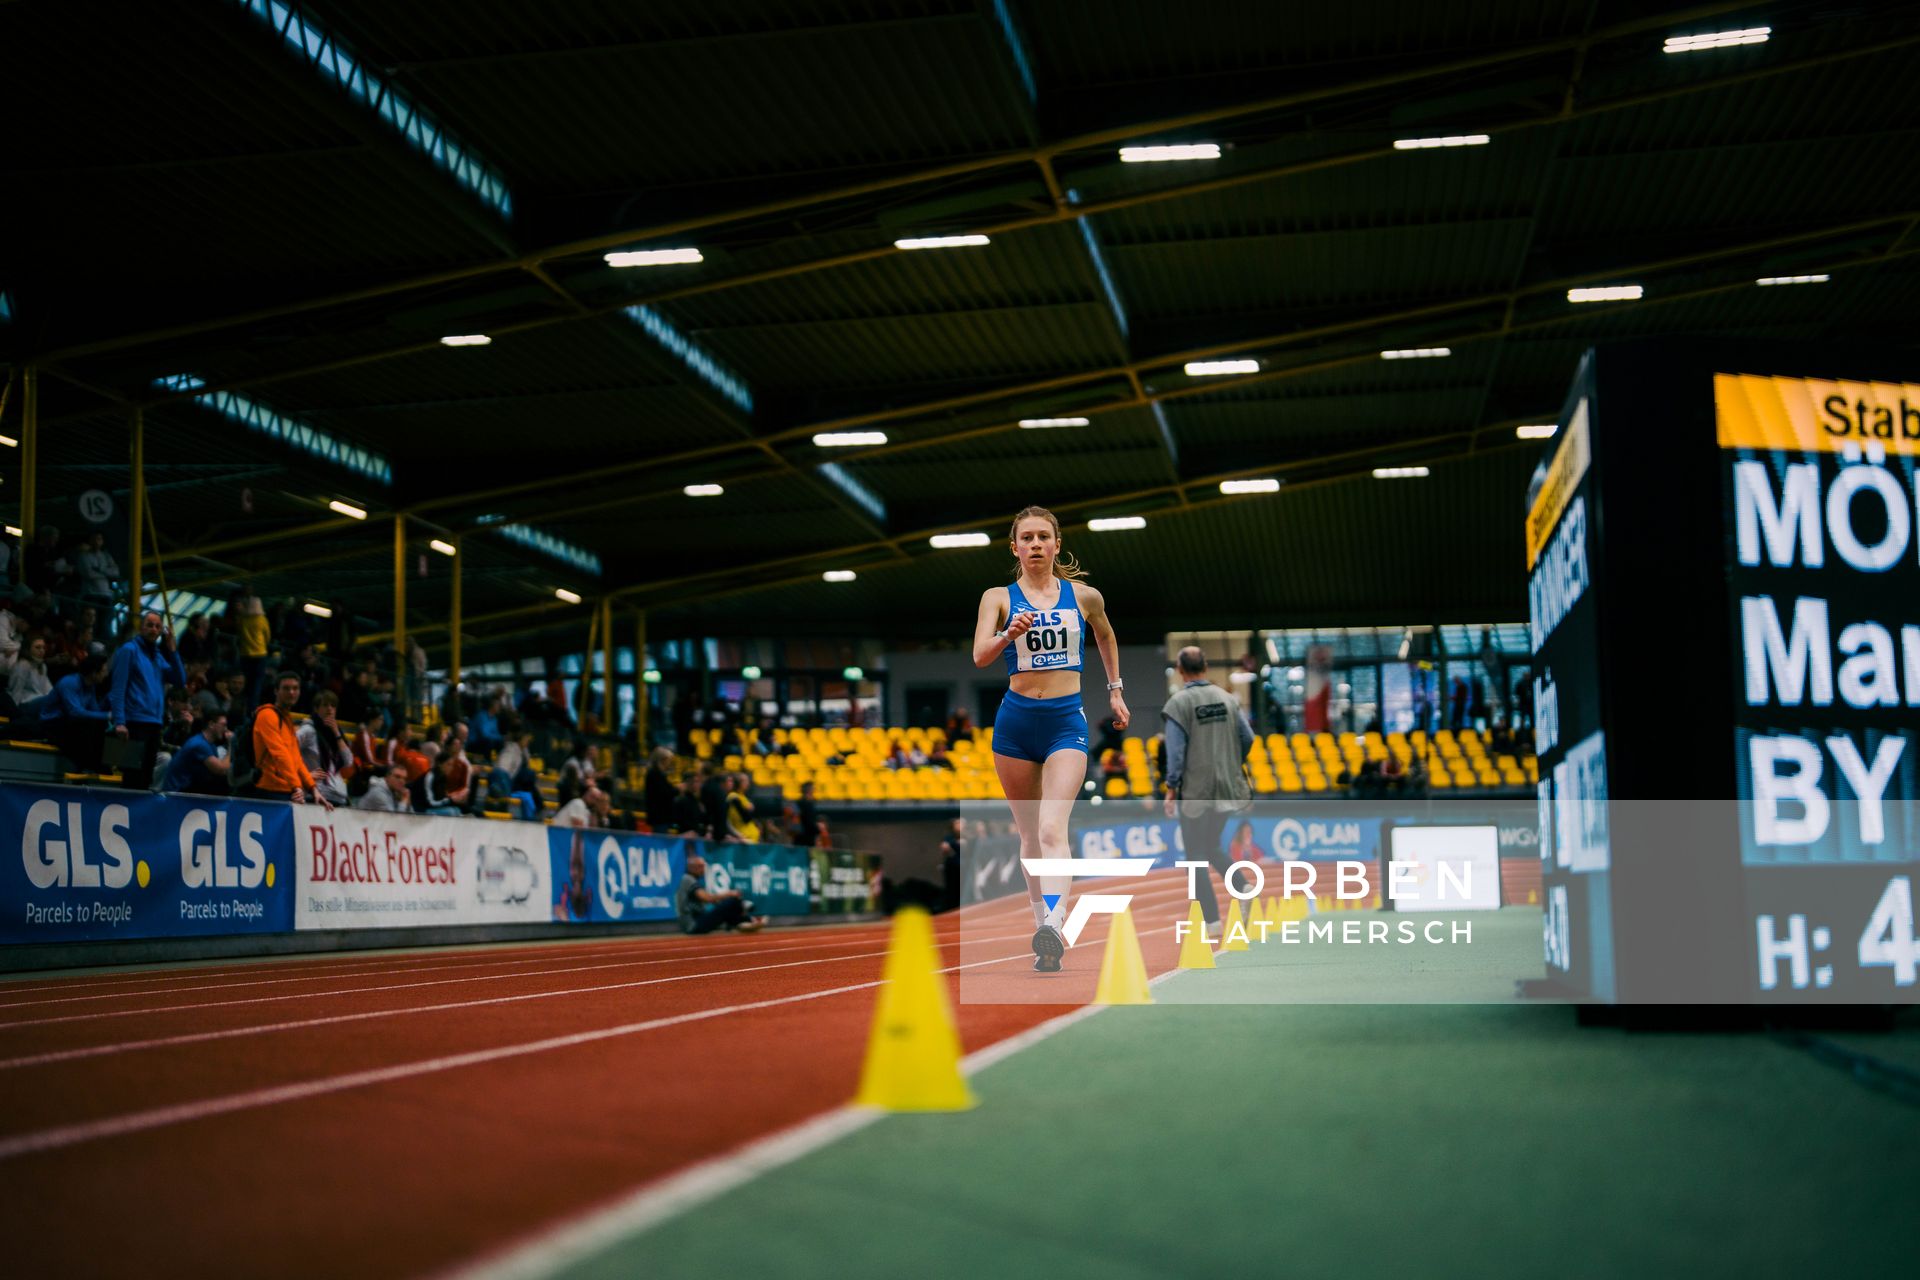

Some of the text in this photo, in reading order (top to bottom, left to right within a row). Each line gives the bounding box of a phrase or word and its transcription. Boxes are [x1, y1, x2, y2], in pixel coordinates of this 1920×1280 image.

[1733, 440, 1920, 572] MÖ
[1026, 627, 1068, 652] 601
[1047, 653, 1066, 662] PLAN
[1749, 733, 1906, 845] BY
[1308, 822, 1360, 845] PLAN
[309, 824, 456, 884] Black Forest
[627, 847, 671, 887] PLAN
[26, 901, 132, 927] Parcels to People
[180, 900, 263, 923] Parcels to People
[1756, 914, 1833, 990] H:
